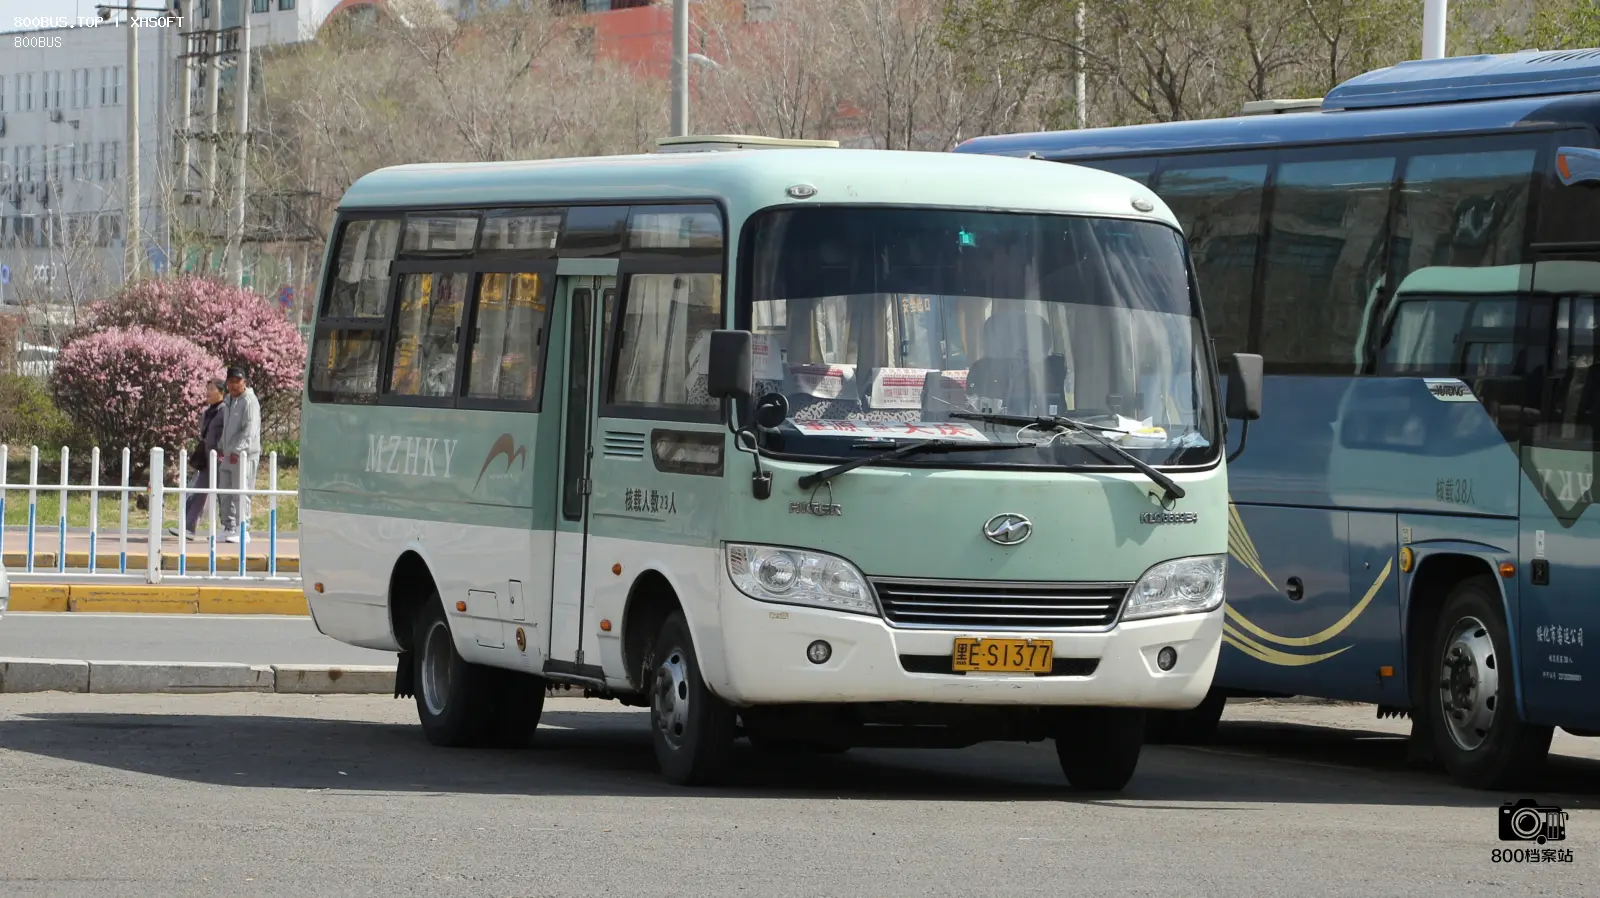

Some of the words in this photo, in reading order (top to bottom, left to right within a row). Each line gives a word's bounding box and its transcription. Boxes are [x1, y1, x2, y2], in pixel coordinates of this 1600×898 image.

[365, 434, 458, 478] MZHKY
[625, 488, 677, 514] 核载人数23人
